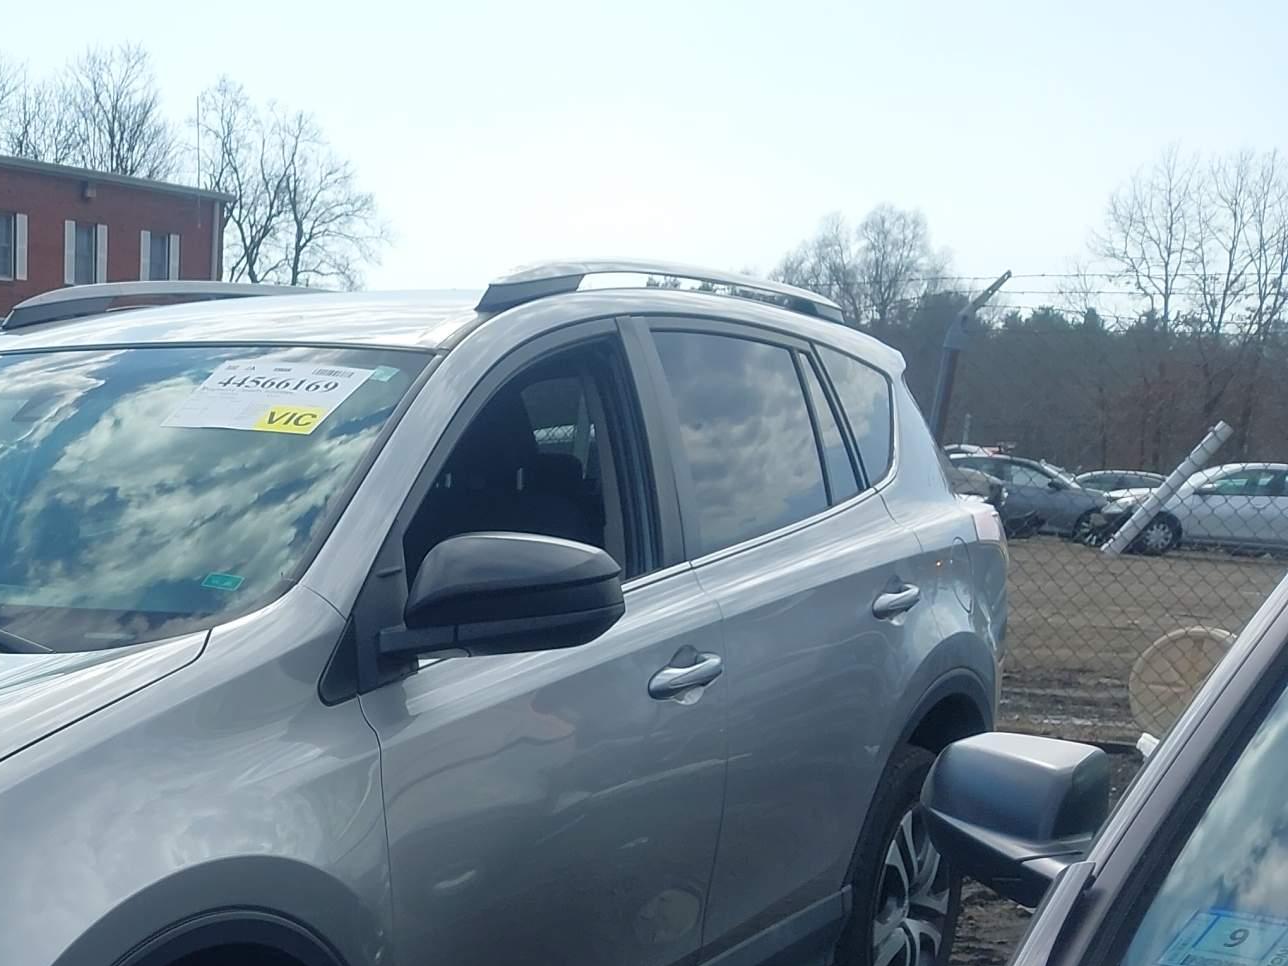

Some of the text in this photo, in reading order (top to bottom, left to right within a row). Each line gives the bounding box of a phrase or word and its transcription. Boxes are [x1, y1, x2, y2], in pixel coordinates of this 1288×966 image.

[217, 375, 340, 393] 44566169
[267, 411, 318, 427] VIC
[1223, 928, 1250, 948] 9
